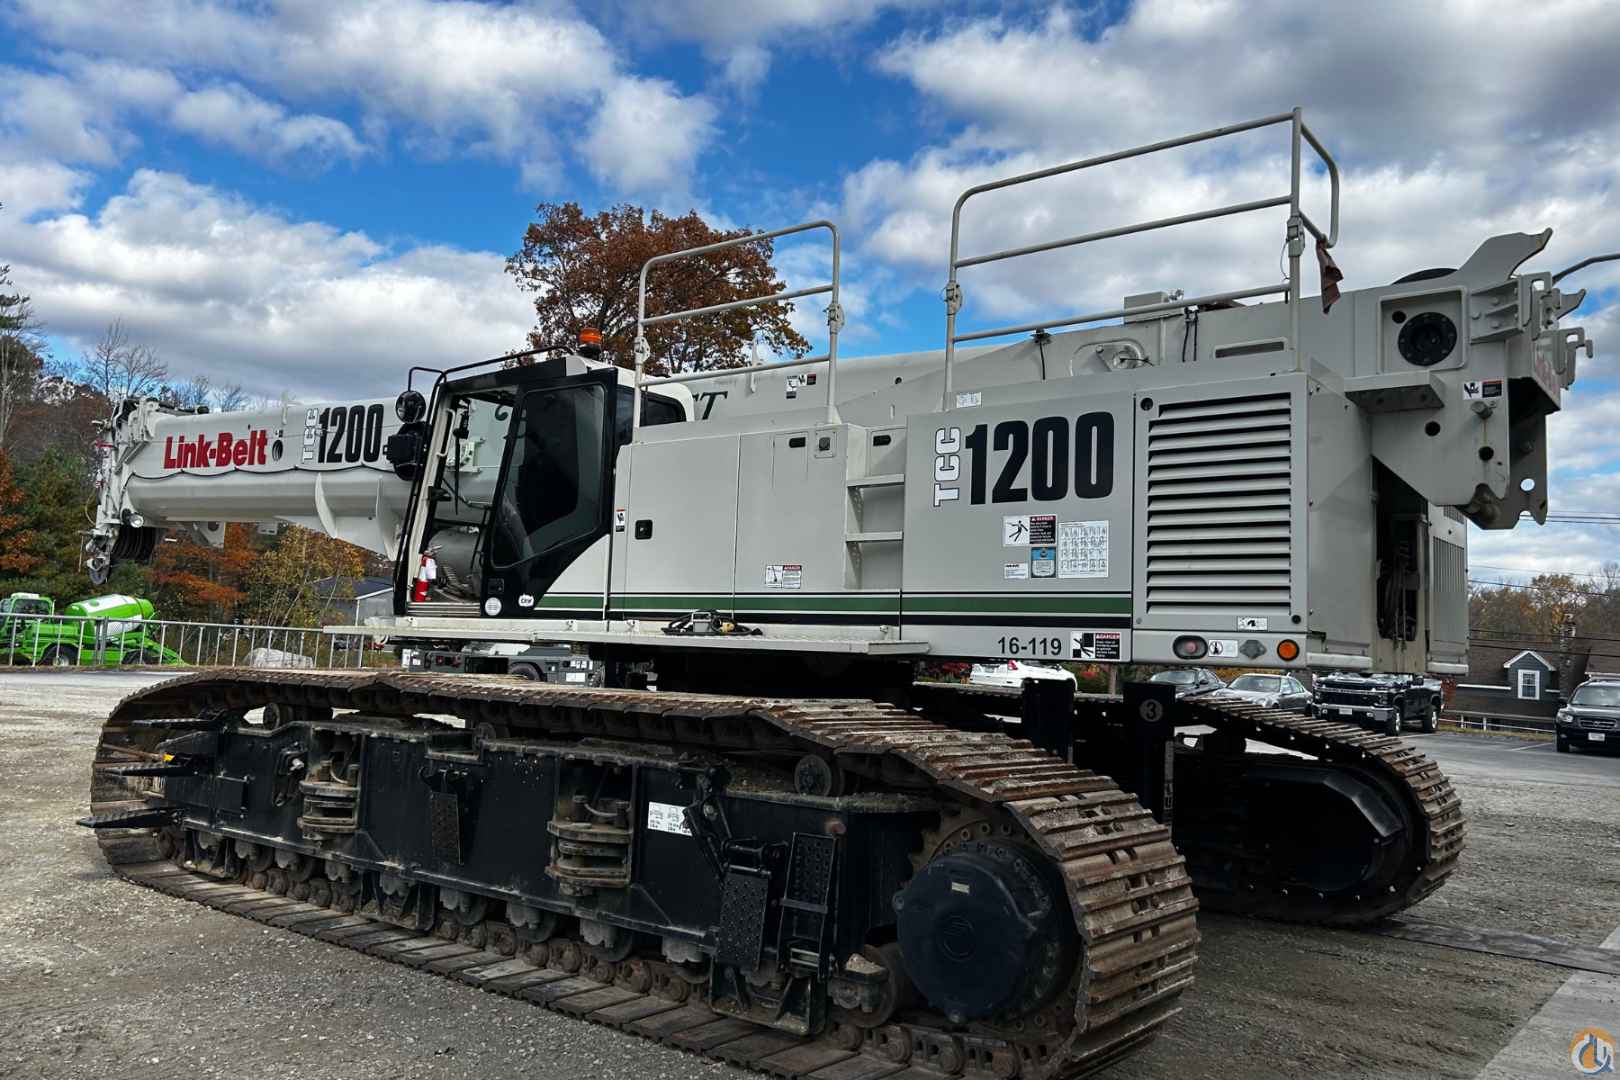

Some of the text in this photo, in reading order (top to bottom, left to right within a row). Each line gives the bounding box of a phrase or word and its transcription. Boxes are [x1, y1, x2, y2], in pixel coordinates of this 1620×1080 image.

[163, 429, 267, 469] Link-Belt
[318, 404, 384, 464] 1200
[933, 411, 1115, 507] TCC 1200
[998, 636, 1062, 656] 16-119
